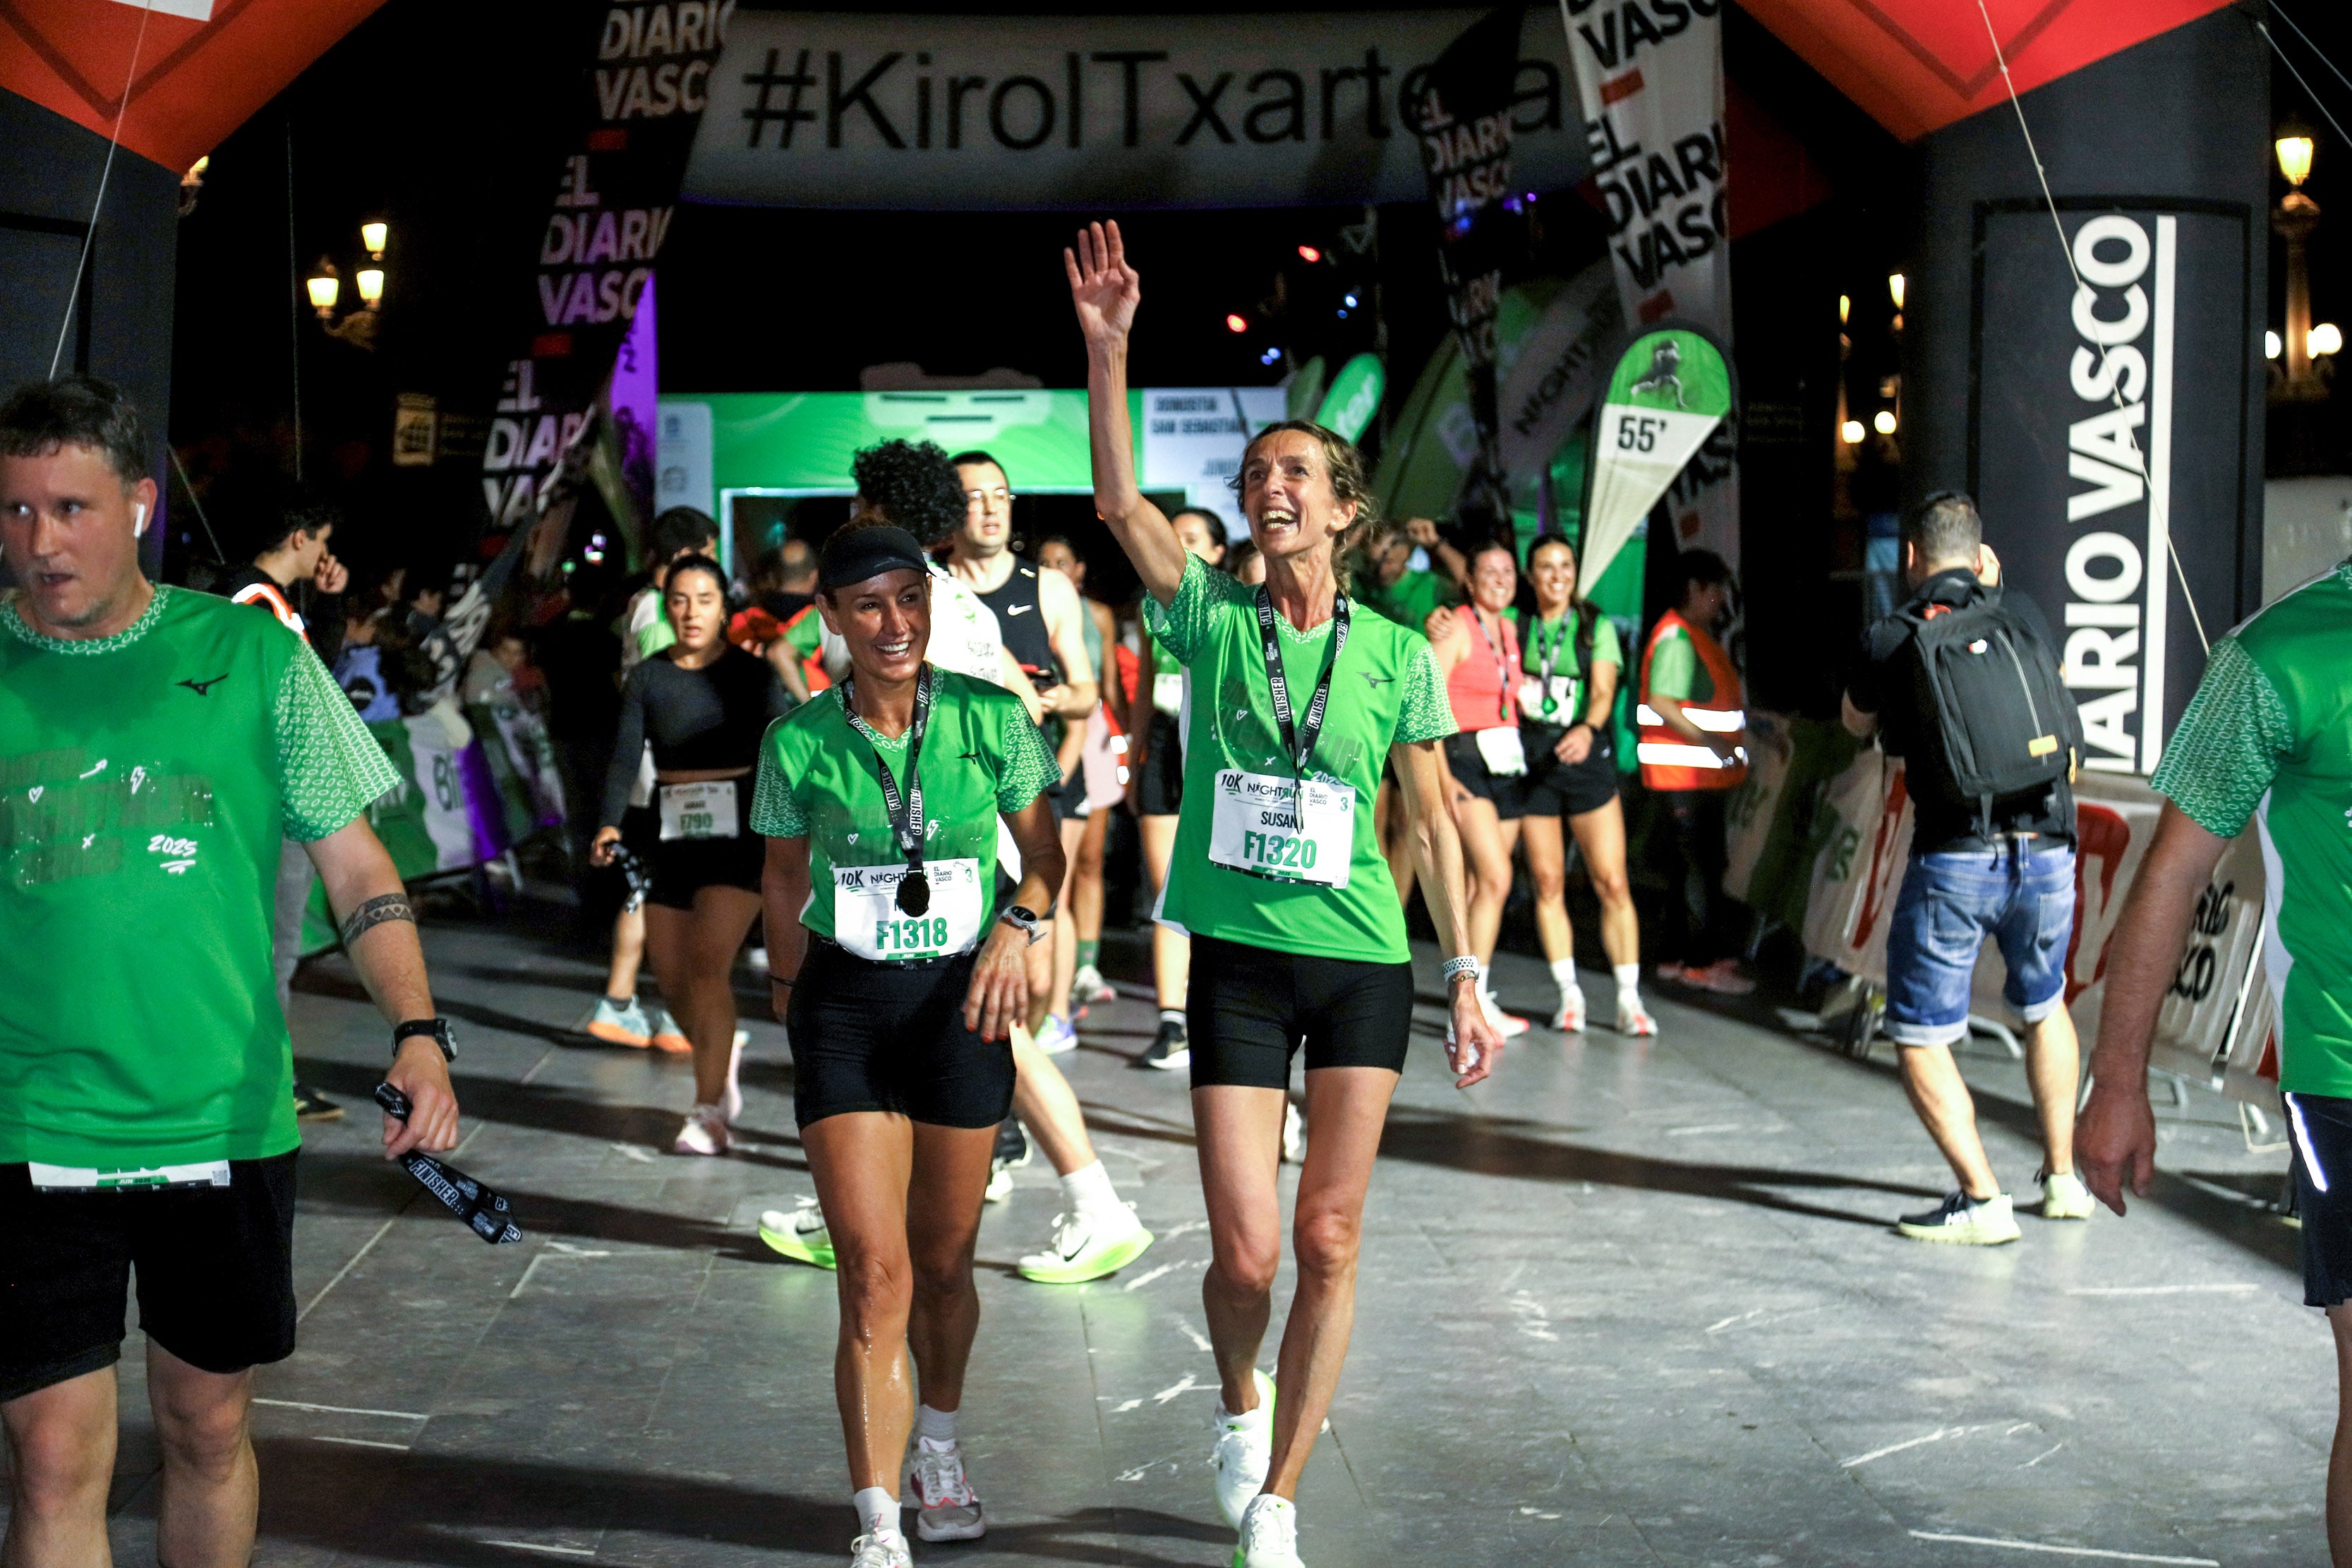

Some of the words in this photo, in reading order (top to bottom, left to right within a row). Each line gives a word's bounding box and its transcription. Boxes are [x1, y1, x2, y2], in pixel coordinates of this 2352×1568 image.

[1577, 0, 1719, 68] VAS
[2068, 214, 2151, 522] VASCO
[1618, 415, 1667, 452] 55'
[1270, 677, 1291, 723] FINISHER
[1306, 683, 1329, 730] FINISHER
[881, 766, 902, 811] FINISHER
[1222, 773, 1243, 792] 10K
[1340, 797, 1349, 812] 3
[910, 788, 923, 836] FINISHER
[147, 834, 198, 857] 2025
[1243, 830, 1317, 869] F1320
[838, 869, 864, 887] 10K
[965, 869, 973, 883] 3
[876, 917, 948, 950] F1318
[409, 1159, 459, 1206] FINISHER
